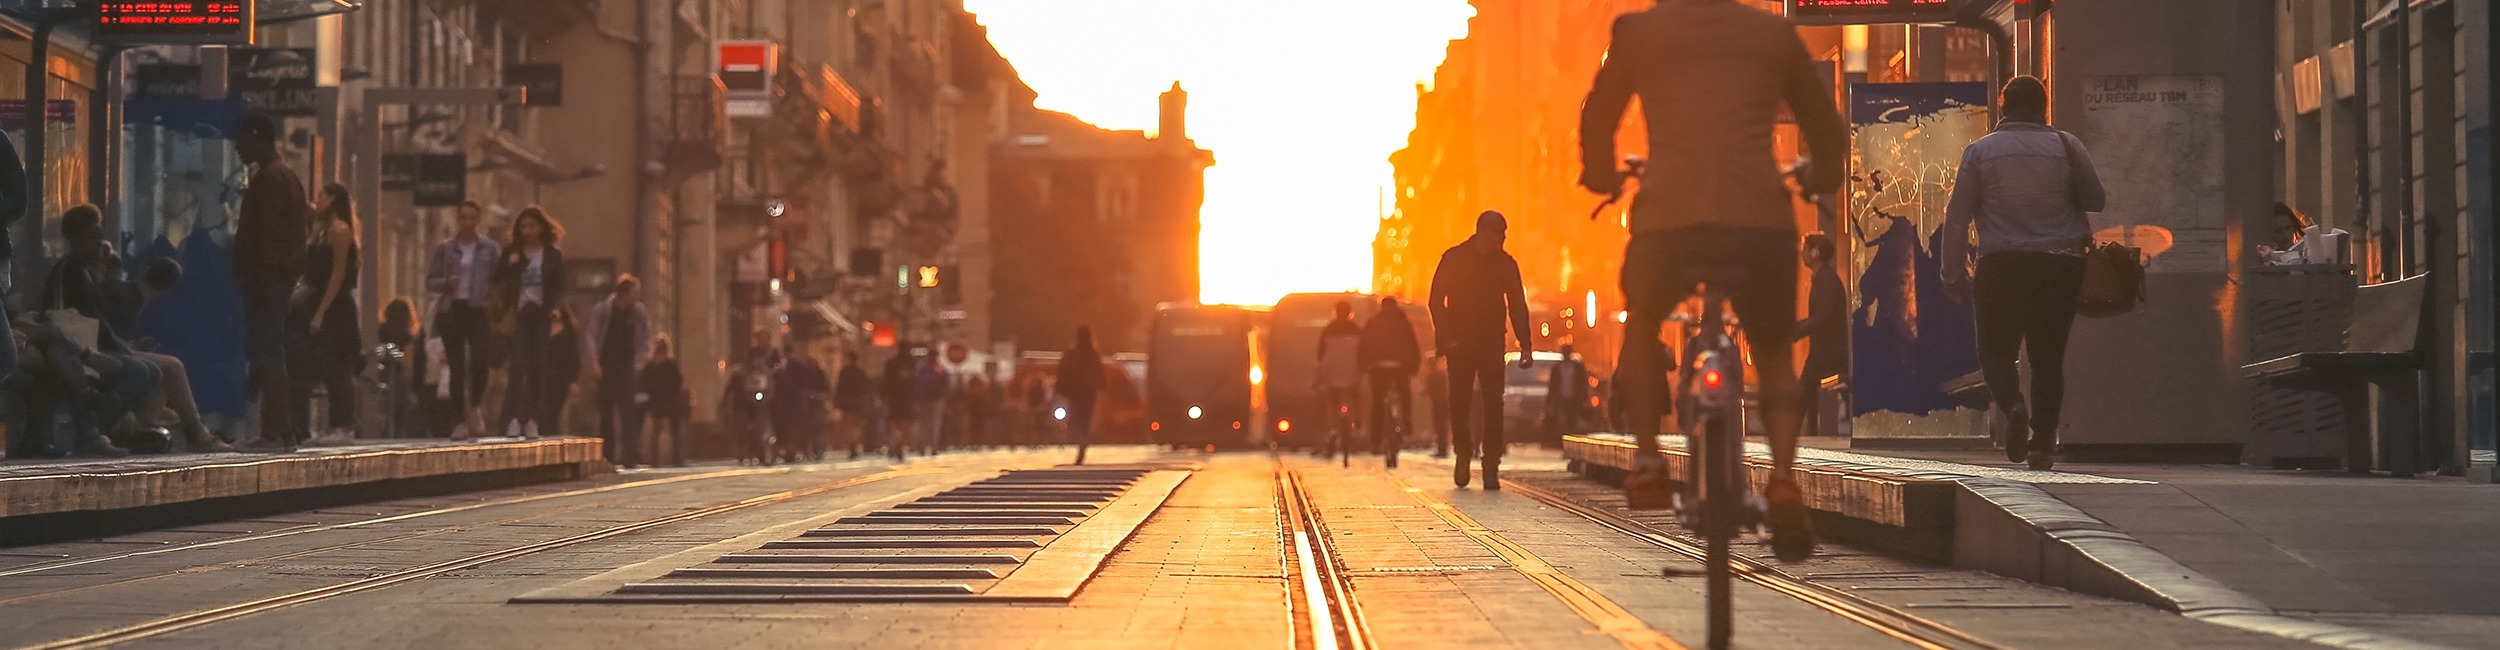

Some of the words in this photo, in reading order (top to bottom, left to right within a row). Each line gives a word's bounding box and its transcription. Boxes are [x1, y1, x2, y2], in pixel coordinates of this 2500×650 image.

[2093, 77, 2139, 92] PLAN
[2085, 93, 2102, 103] DU
[2105, 90, 2157, 103] RÉSEAU
[2160, 91, 2187, 102] TBM
